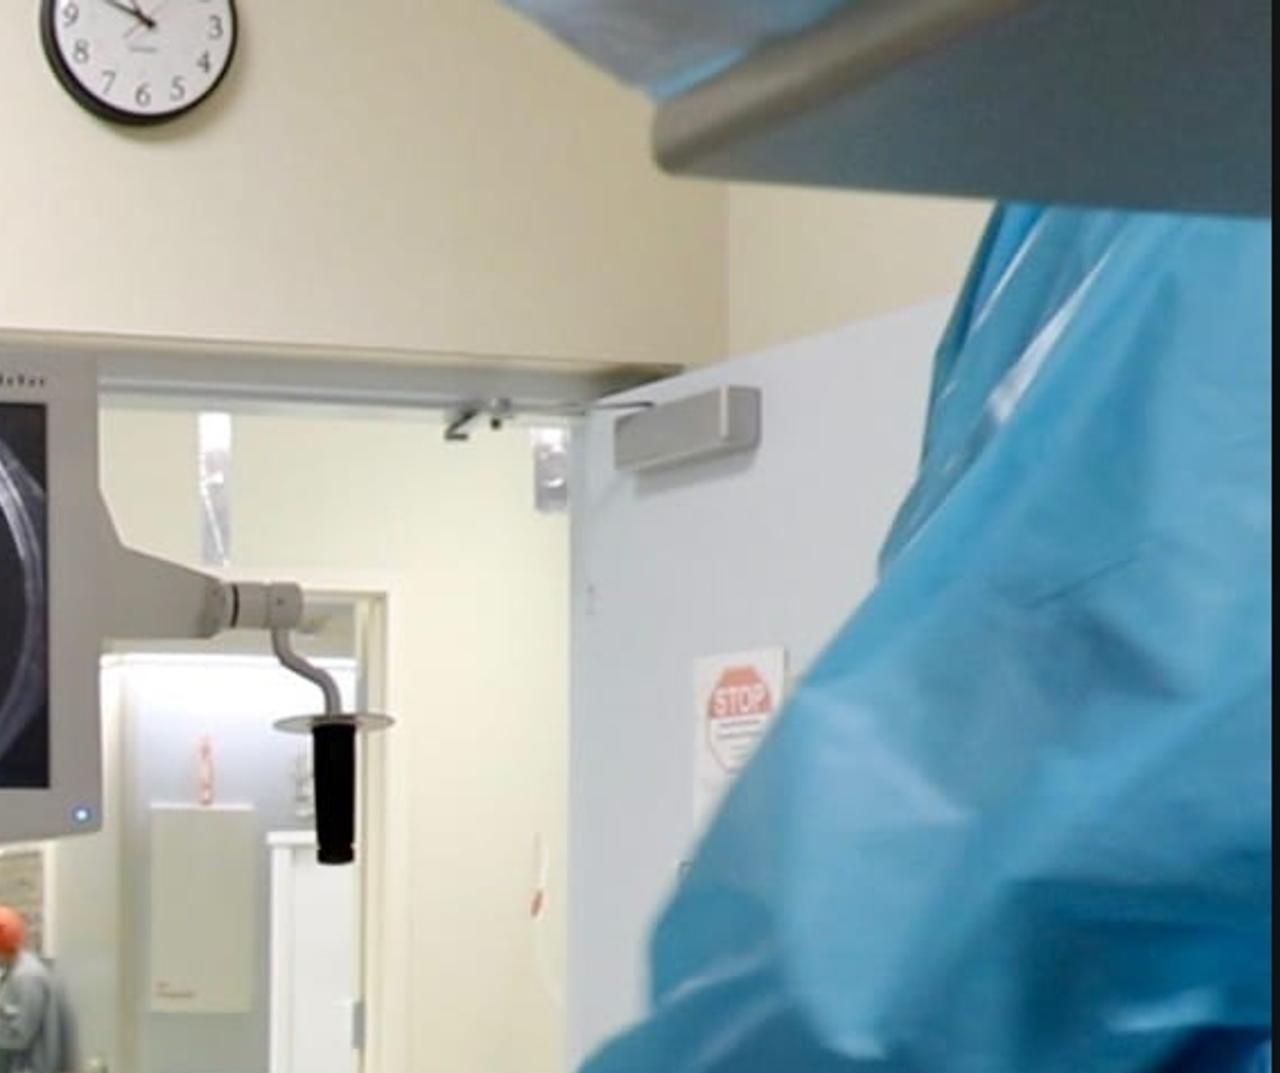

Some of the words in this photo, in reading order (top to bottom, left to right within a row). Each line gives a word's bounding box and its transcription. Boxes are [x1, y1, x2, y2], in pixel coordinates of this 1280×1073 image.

[62, 4, 79, 28] 9
[208, 16, 223, 40] 3
[72, 39, 90, 63] 8
[196, 51, 212, 74] 4
[102, 71, 116, 95] 7
[135, 83, 151, 107] 6
[169, 76, 186, 101] 5
[713, 683, 767, 715] STOP
